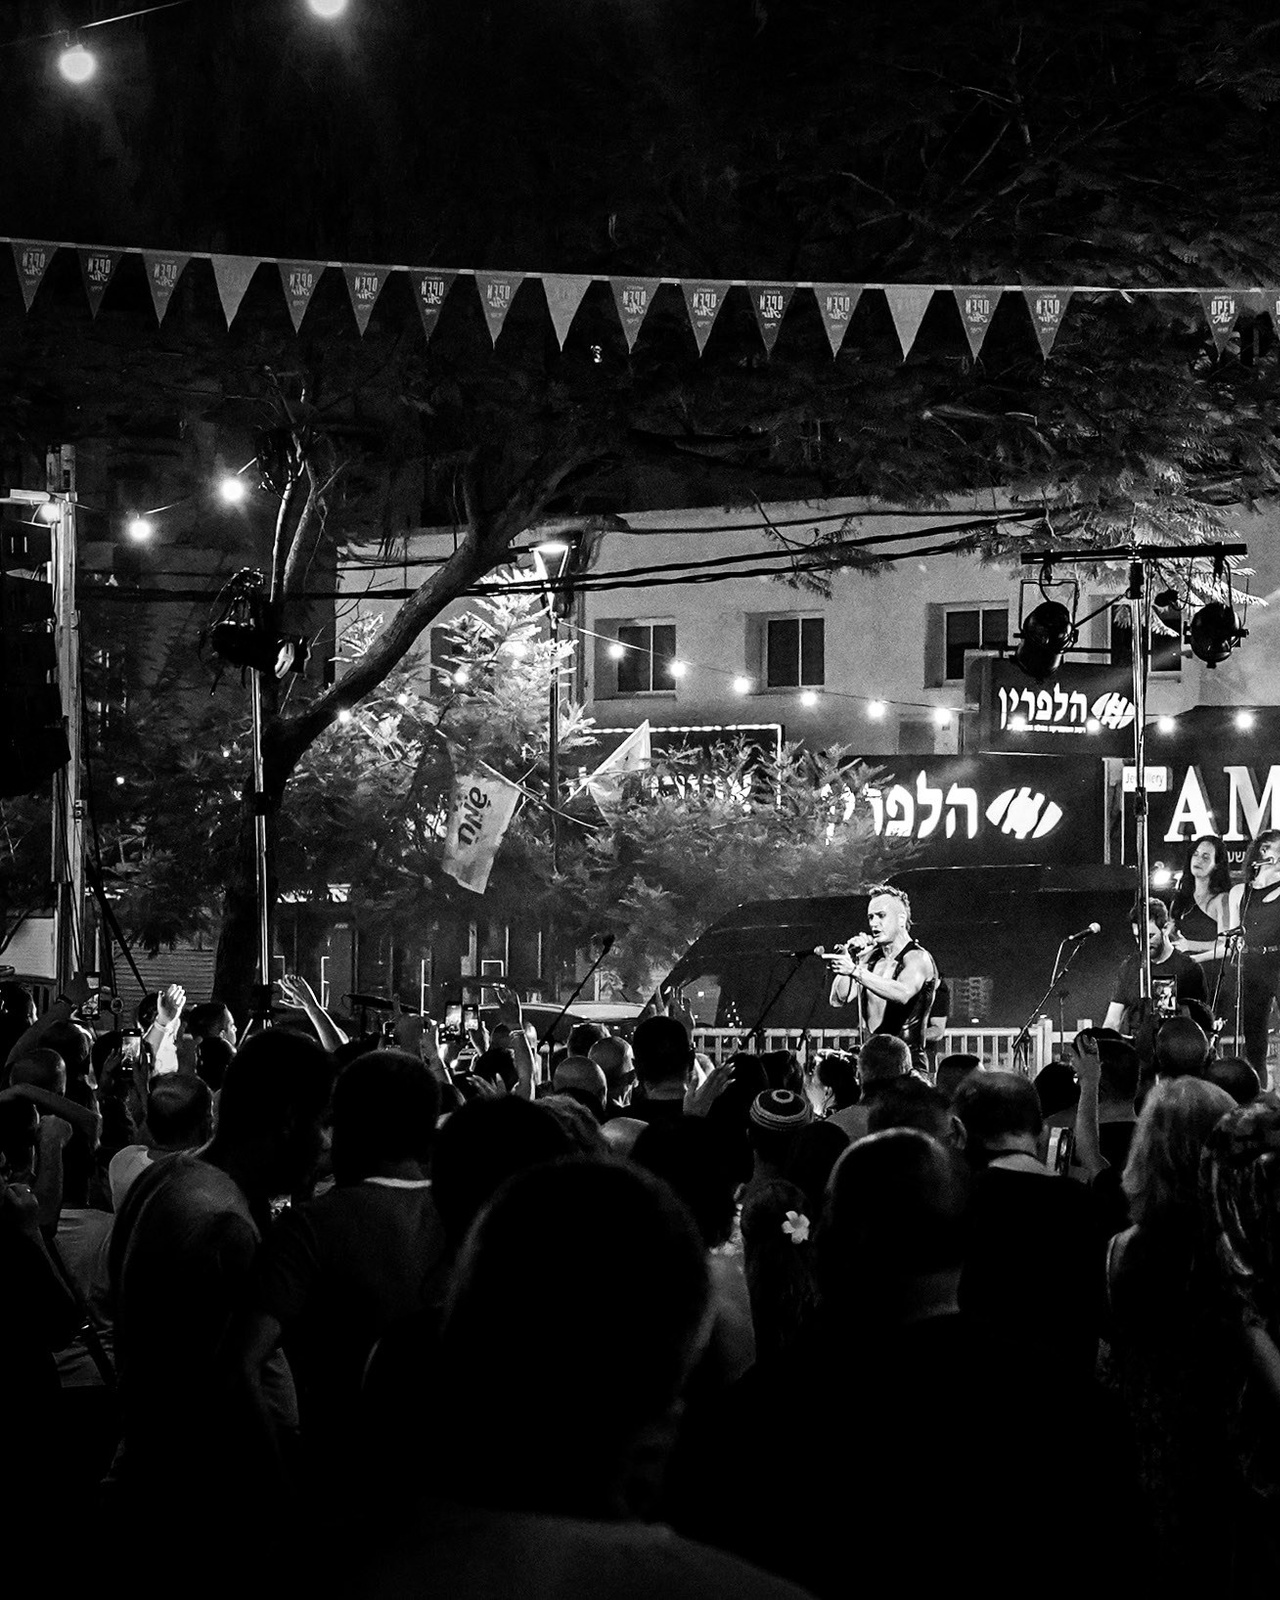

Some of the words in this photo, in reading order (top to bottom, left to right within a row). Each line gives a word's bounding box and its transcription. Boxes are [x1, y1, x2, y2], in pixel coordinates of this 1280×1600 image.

[1210, 300, 1235, 316] OPEN
[1212, 311, 1232, 325] Air
[998, 682, 1088, 730] הלפרין
[1125, 773, 1164, 787] Jellery
